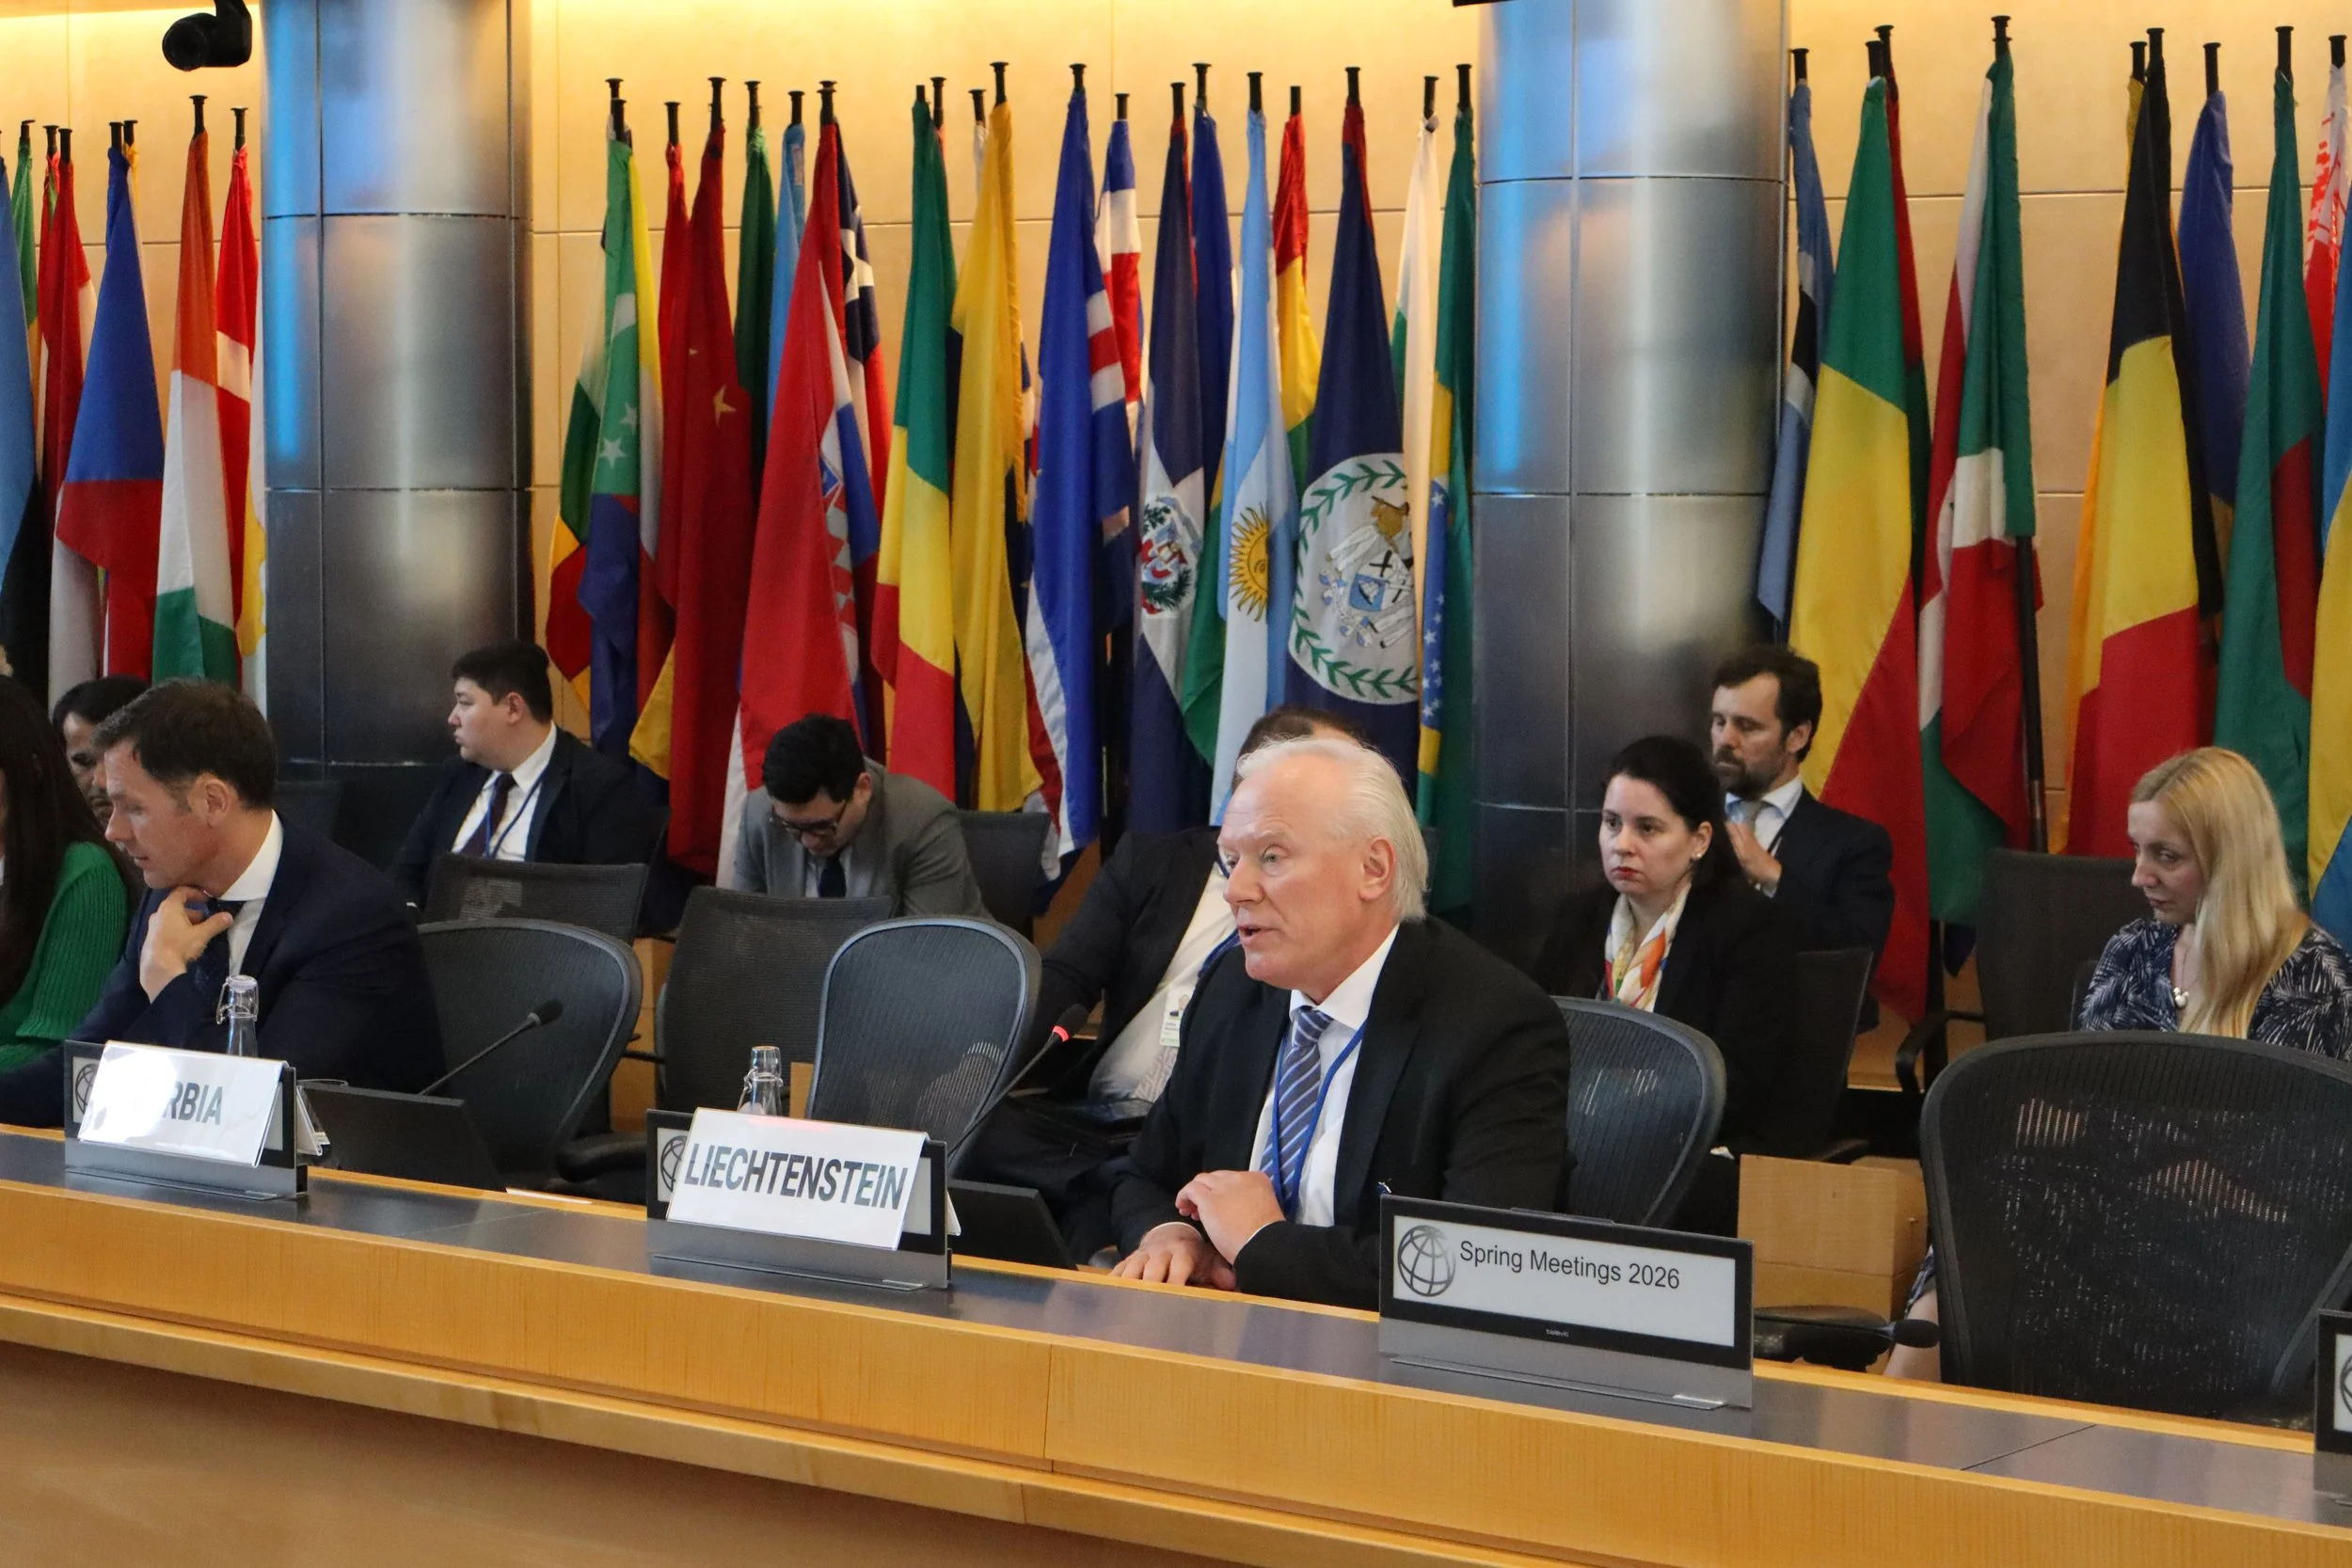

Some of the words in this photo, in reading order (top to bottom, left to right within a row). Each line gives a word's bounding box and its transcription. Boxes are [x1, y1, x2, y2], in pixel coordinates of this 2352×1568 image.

[161, 1080, 224, 1126] RBIA
[683, 1143, 909, 1211] LIECHTENSTEIN
[1460, 1240, 1523, 1274] Spring
[1530, 1249, 1622, 1286] Meetings
[1629, 1262, 1680, 1290] 2026
